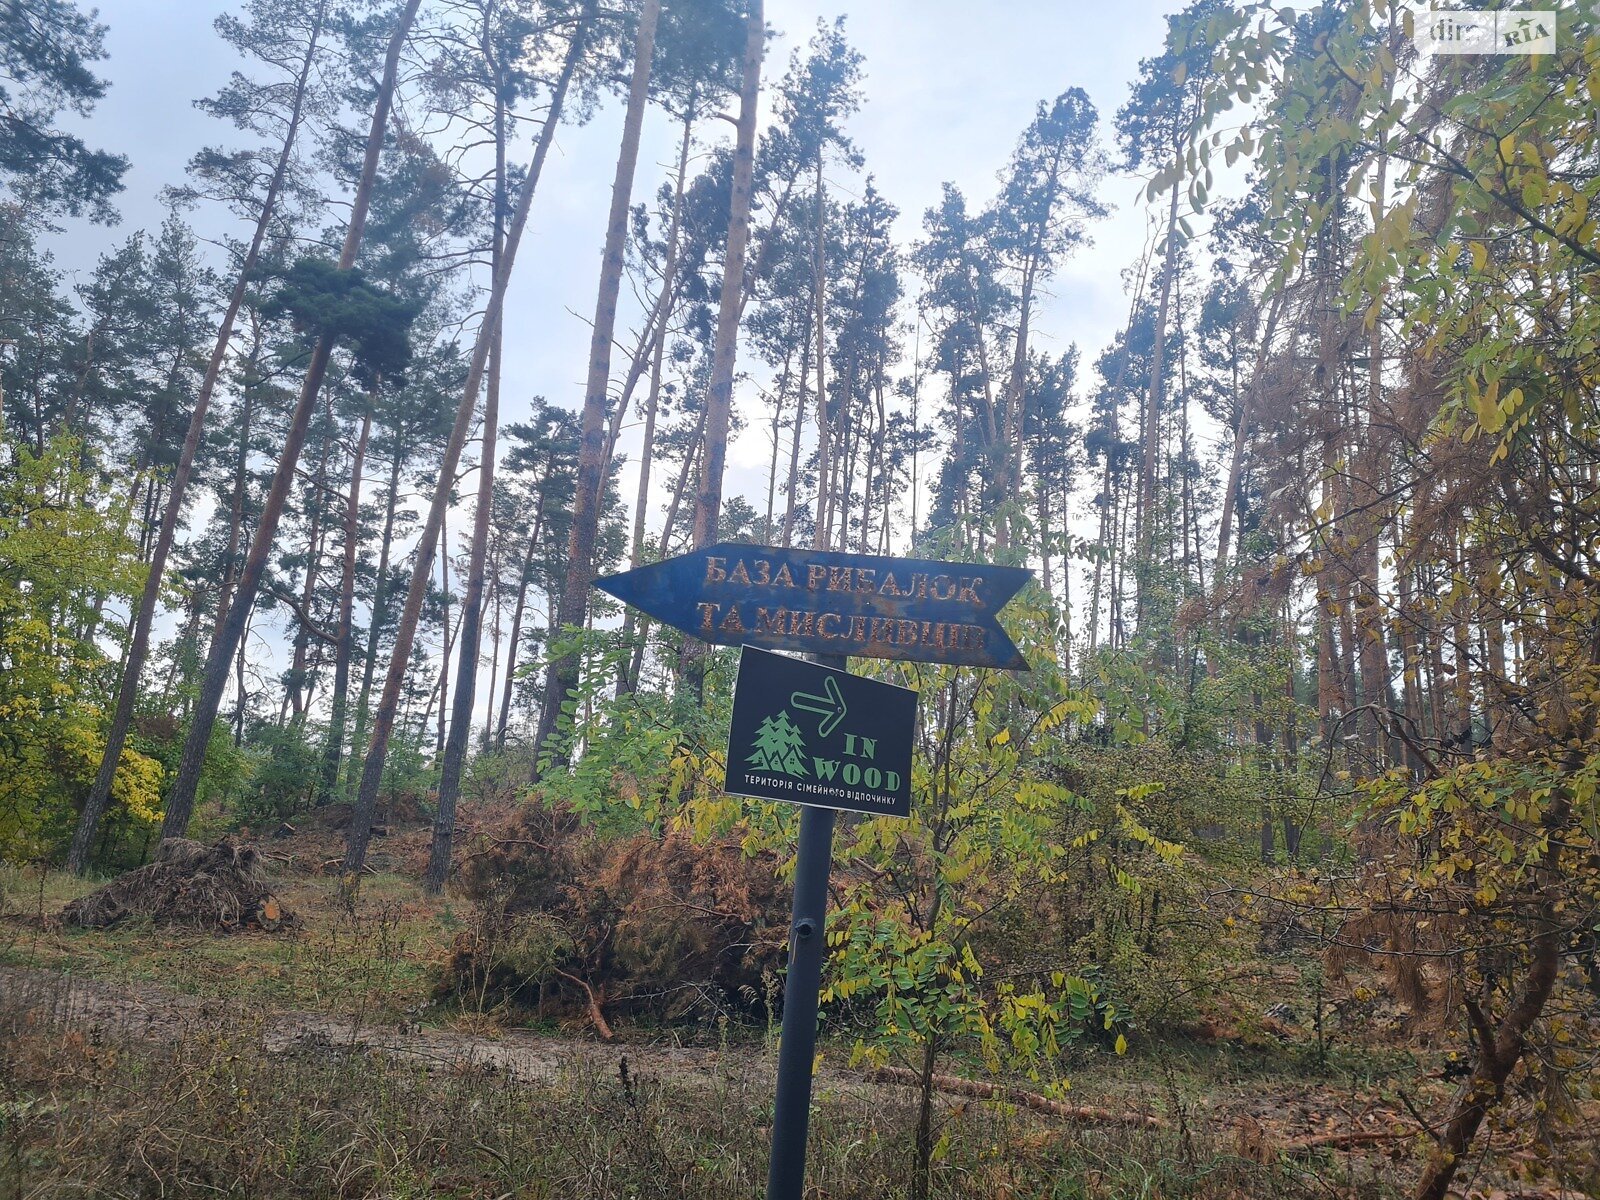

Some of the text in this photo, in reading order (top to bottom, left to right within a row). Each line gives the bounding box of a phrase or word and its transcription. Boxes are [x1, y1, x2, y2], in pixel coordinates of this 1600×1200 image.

[706, 556, 983, 603] БАЗА РИБАЛОК
[698, 602, 746, 632] ТА
[843, 733, 877, 759] IN
[744, 774, 896, 805] ТЕРИТОРІЯ СІМЕЙНОГО ВІДПОЧИНКУ
[812, 757, 900, 791] WOOD
